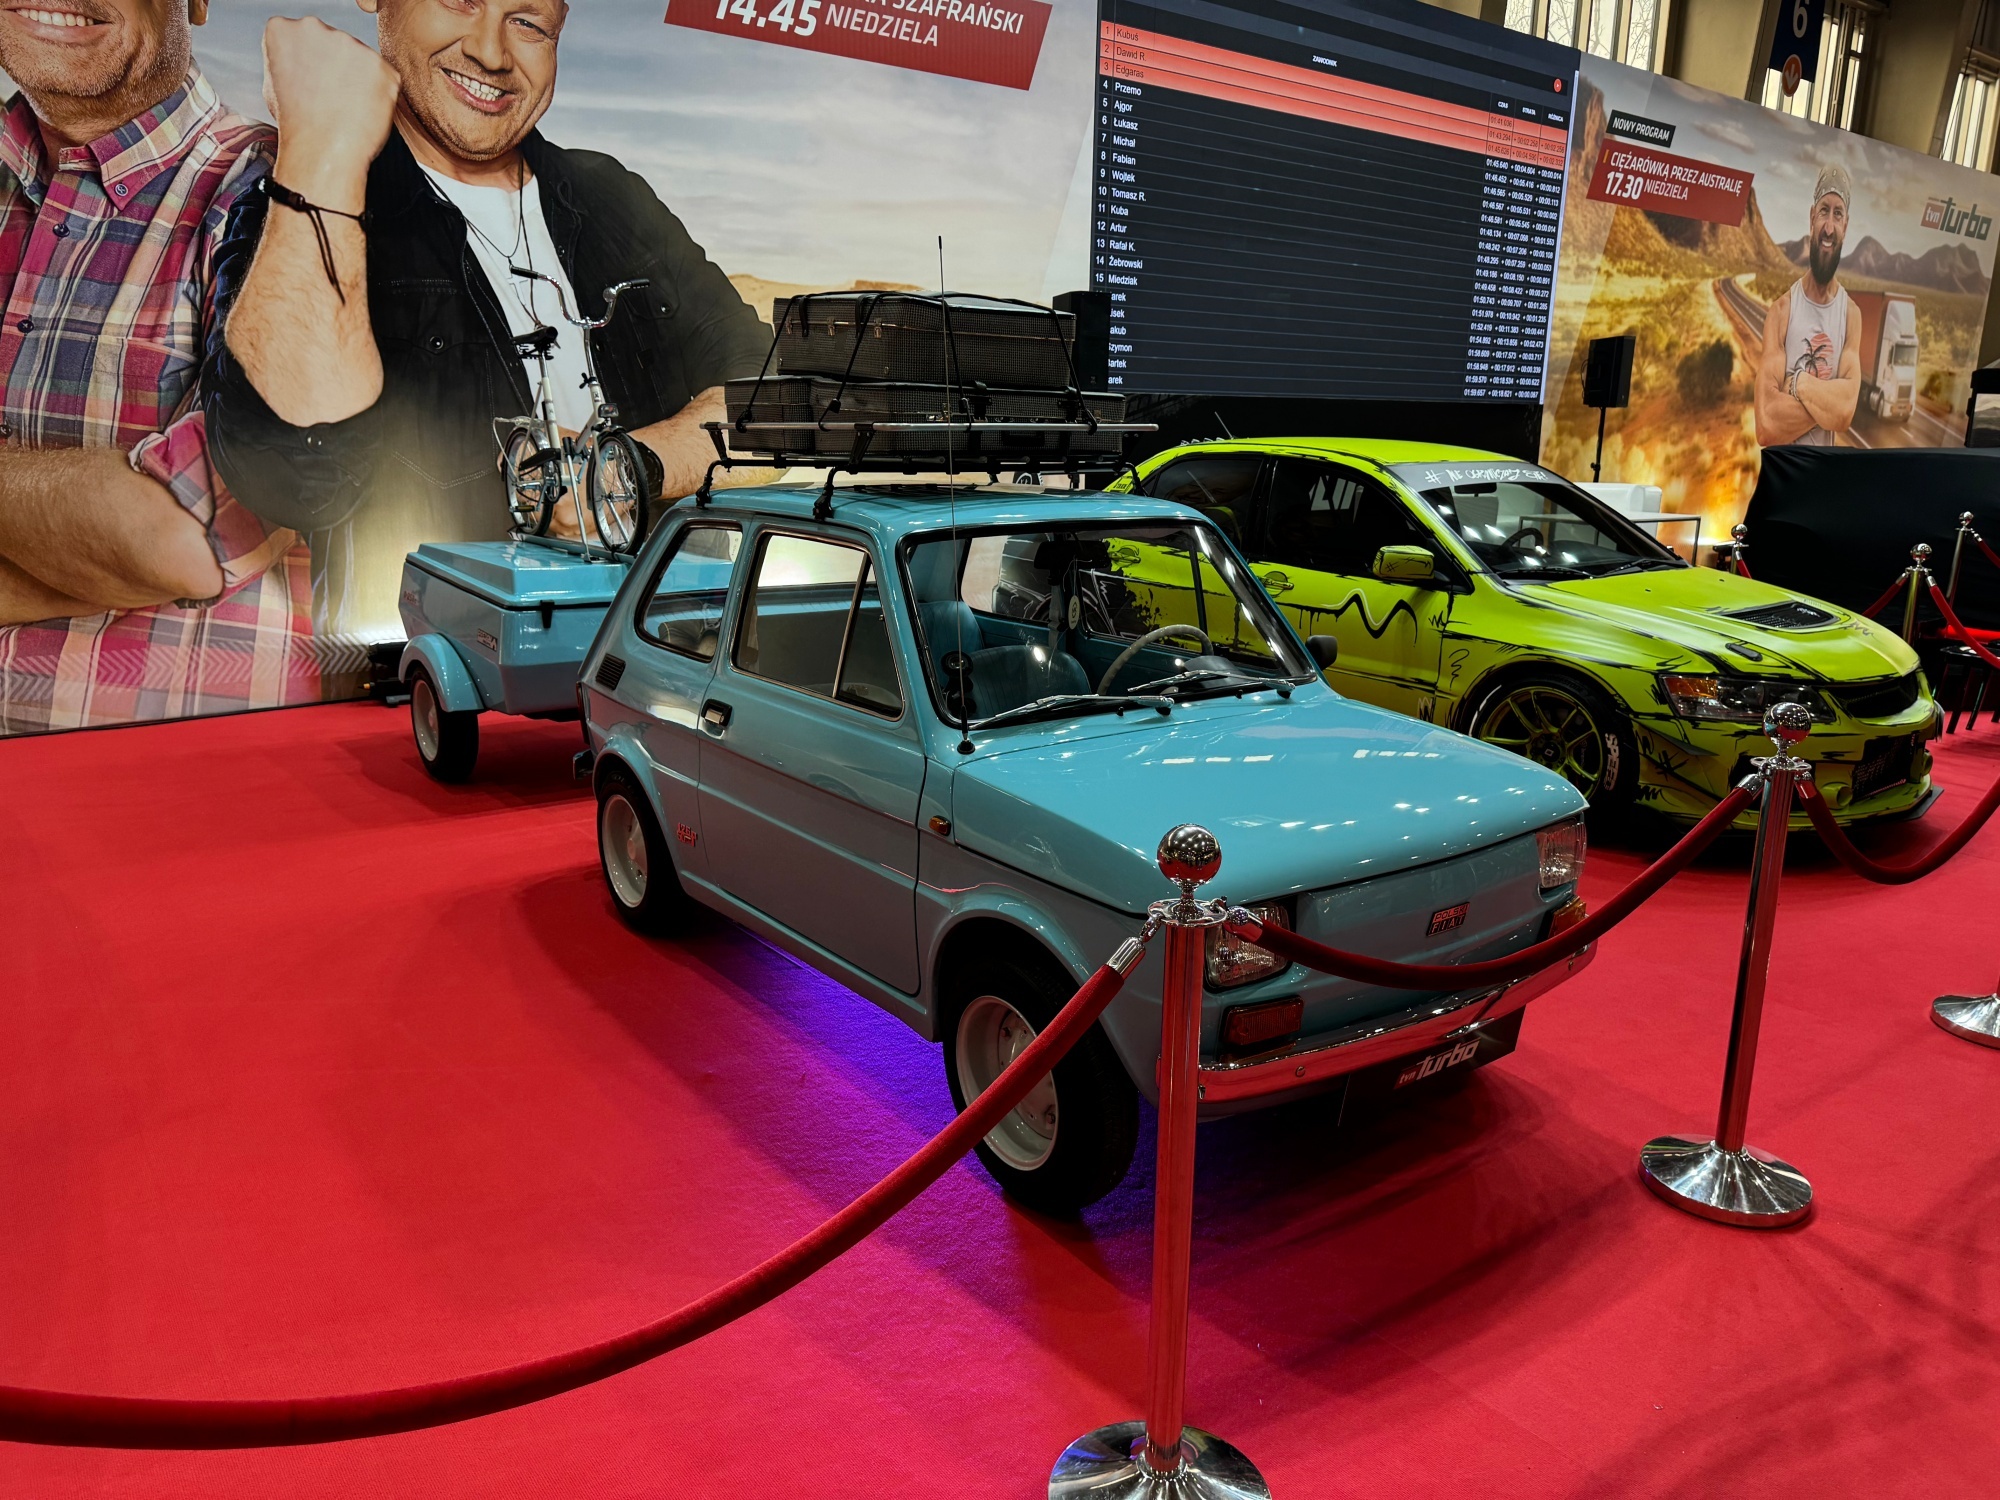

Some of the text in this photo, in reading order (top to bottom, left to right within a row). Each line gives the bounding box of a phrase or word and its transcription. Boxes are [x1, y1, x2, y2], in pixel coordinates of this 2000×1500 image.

[825, 3, 938, 47] NIEDZIELA
[1793, 0, 1809, 38] 6
[1106, 26, 1139, 41] 1 Kubuś
[1105, 44, 1146, 61] 2 Dawid R.
[1104, 62, 1144, 78] 3 Edgaras
[1103, 80, 1142, 95] 4 Przemo
[1103, 98, 1108, 107] 5
[1102, 115, 1138, 130] 6 Łukasz
[1612, 117, 1670, 142] NOWY PROGRAM
[1102, 133, 1106, 142] 7
[1101, 151, 1136, 165] 8 Fabian
[1100, 169, 1135, 183] 9 Wojtek
[1610, 151, 1743, 197] CIĘŻARÓWKĄ PRZEZ AUSTRALIĘ
[1605, 171, 1689, 201] 17.30 NIEDZIELA
[1098, 187, 1146, 201] 10 Tomasz R.
[1098, 204, 1128, 216] 11 Kuba
[1925, 206, 1942, 224] tvn
[1097, 221, 1127, 233] 12 Artur
[1097, 239, 1105, 248] 13
[1129, 242, 1136, 252] K.
[1096, 255, 1143, 269] 14 Żebrowski
[1096, 273, 1137, 285] 15 Miedziak
[1111, 293, 1126, 301] arek
[1110, 326, 1126, 335] akub
[1108, 376, 1123, 384] arek
[1434, 904, 1469, 921] POLSKI
[1431, 915, 1466, 933] FIAT
[1416, 1041, 1480, 1081] turbo
